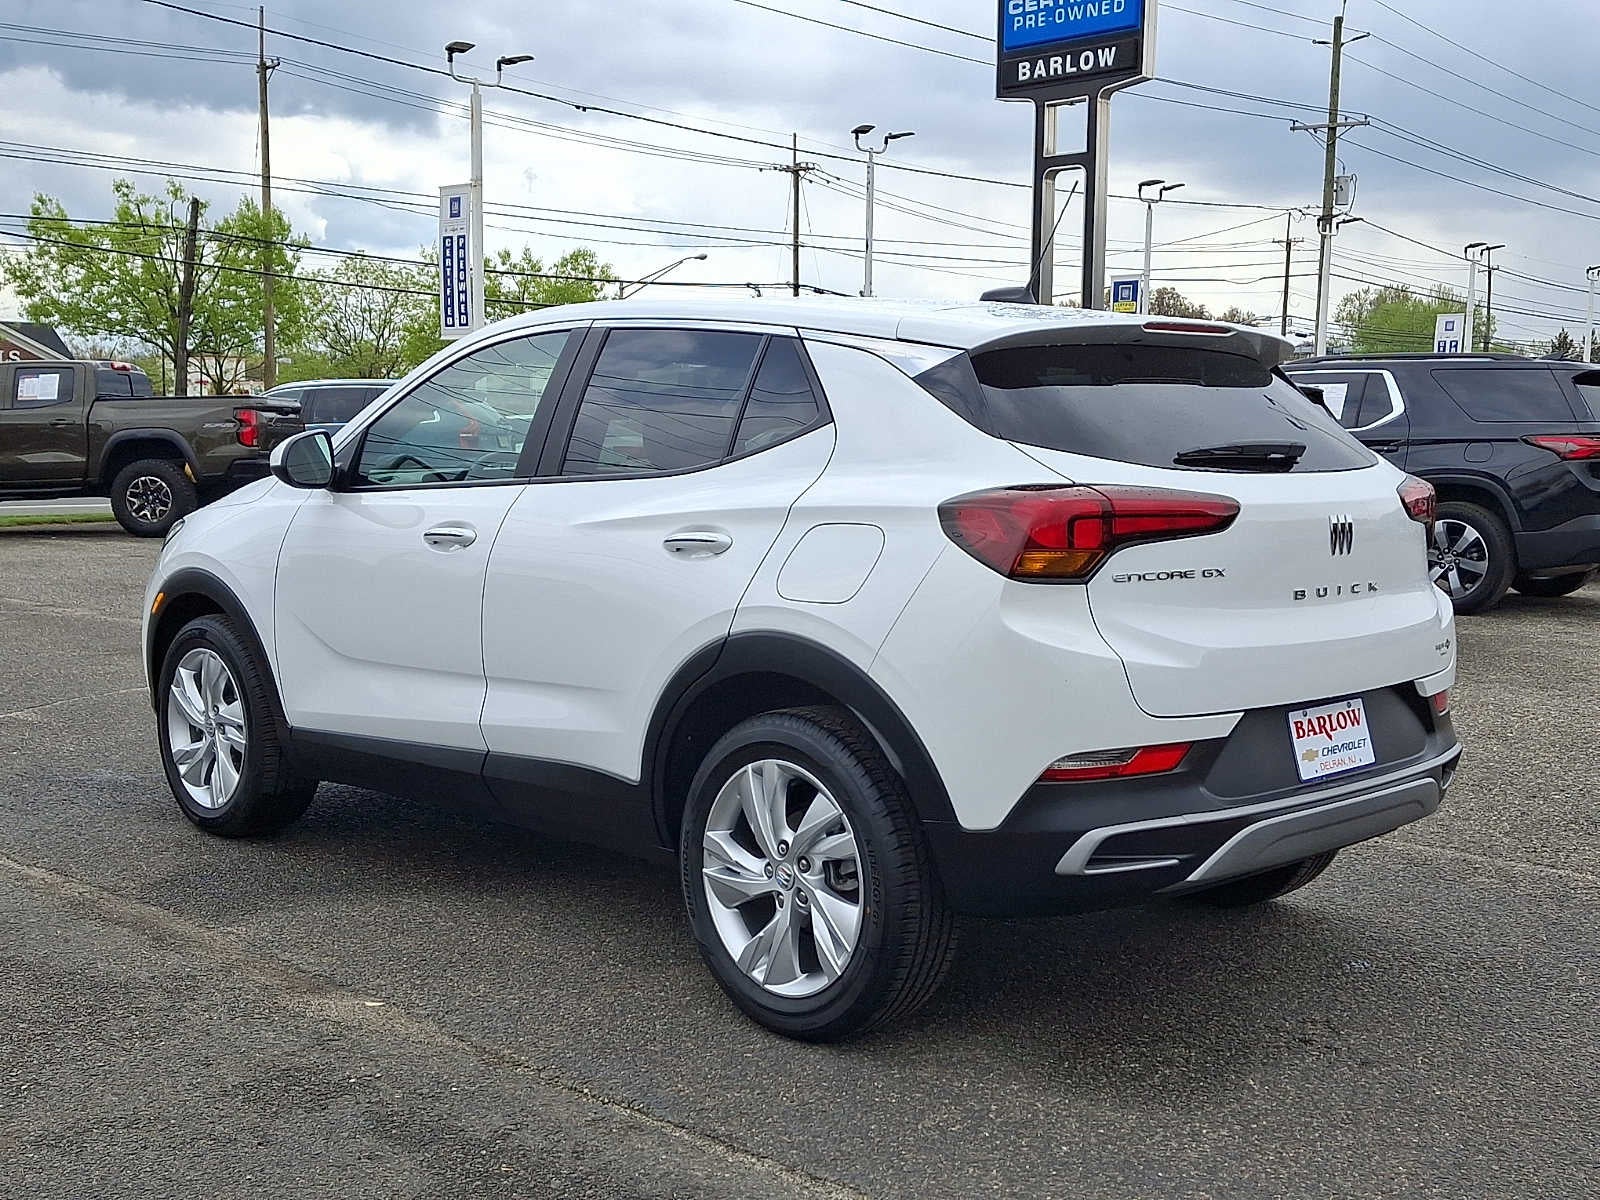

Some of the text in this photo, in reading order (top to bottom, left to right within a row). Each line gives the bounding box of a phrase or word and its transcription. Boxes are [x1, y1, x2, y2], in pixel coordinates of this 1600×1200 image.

[1013, 0, 1125, 31] PRE-OWNED
[1018, 46, 1117, 81] BARLOW
[445, 237, 453, 326] CERTIFIED
[1111, 568, 1225, 583] ENCORE GX
[1293, 582, 1379, 601] BUICK
[1293, 707, 1361, 742] BARLOW
[1321, 737, 1367, 757] CHEVROLET
